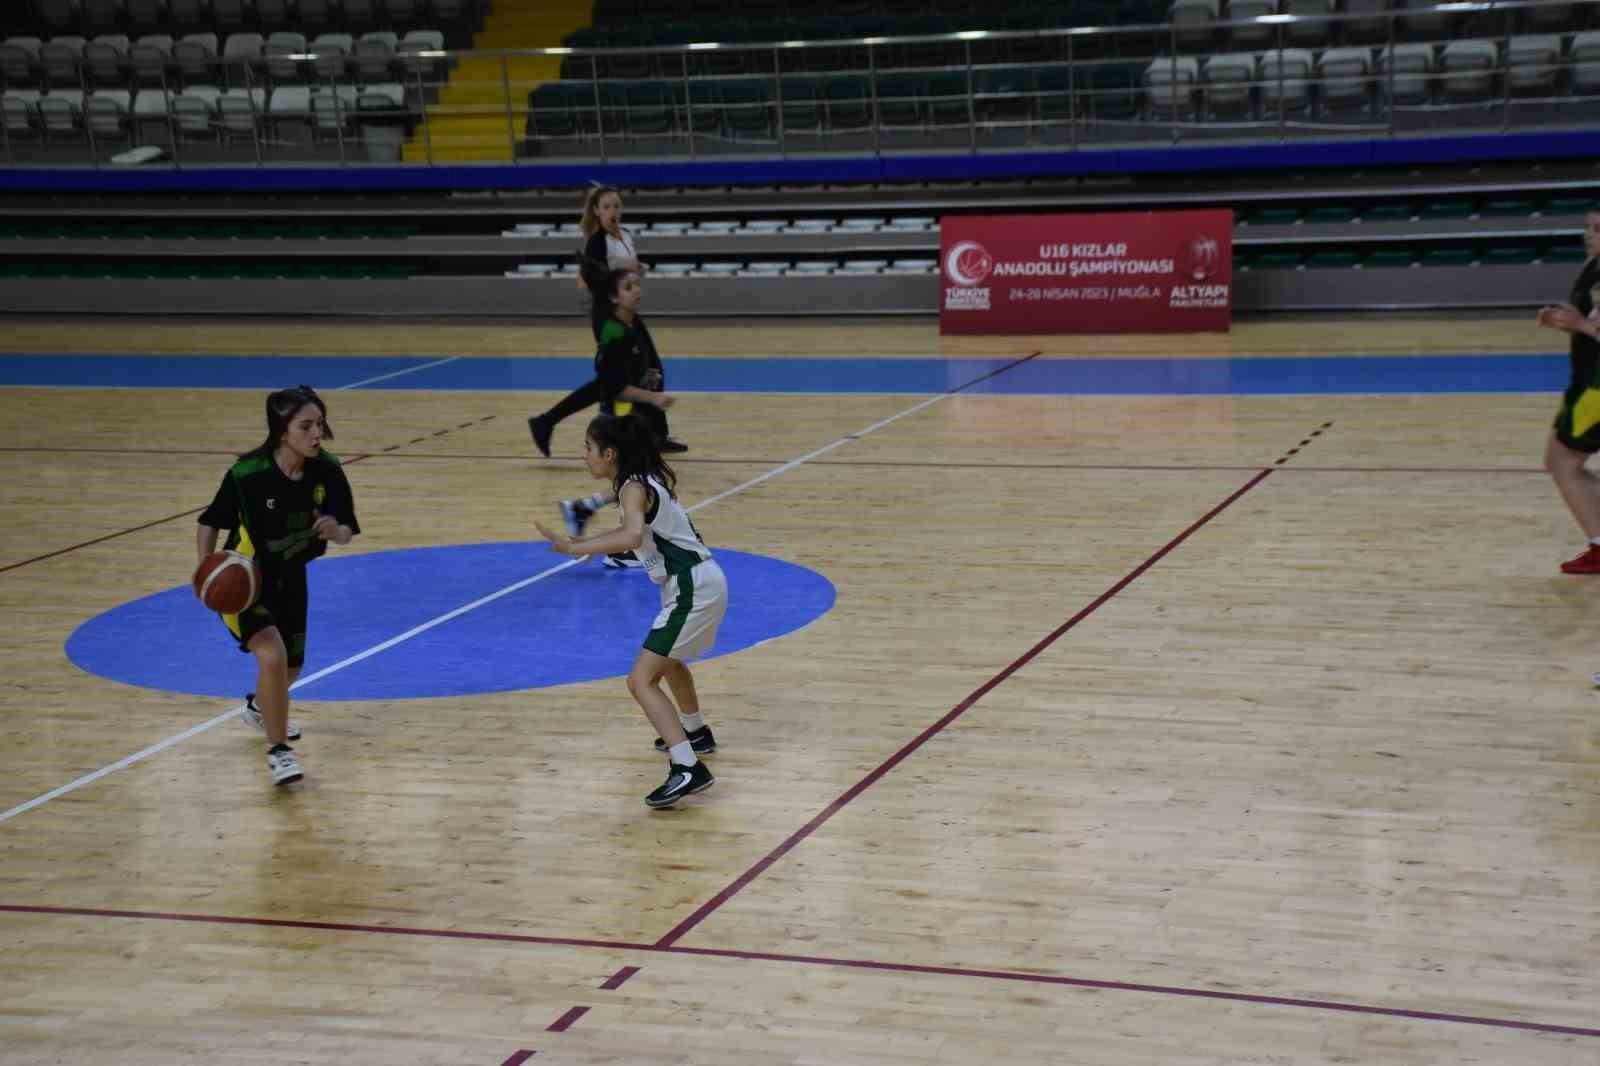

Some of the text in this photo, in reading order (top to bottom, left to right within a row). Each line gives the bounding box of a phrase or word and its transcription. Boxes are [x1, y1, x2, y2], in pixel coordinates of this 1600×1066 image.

[1040, 243, 1127, 258] U16 KIZLAR
[993, 259, 1174, 278] ANADOLU ŞAMPİYONASI
[1118, 285, 1161, 299] MUĞLA
[1170, 284, 1228, 299] ALTYAPI
